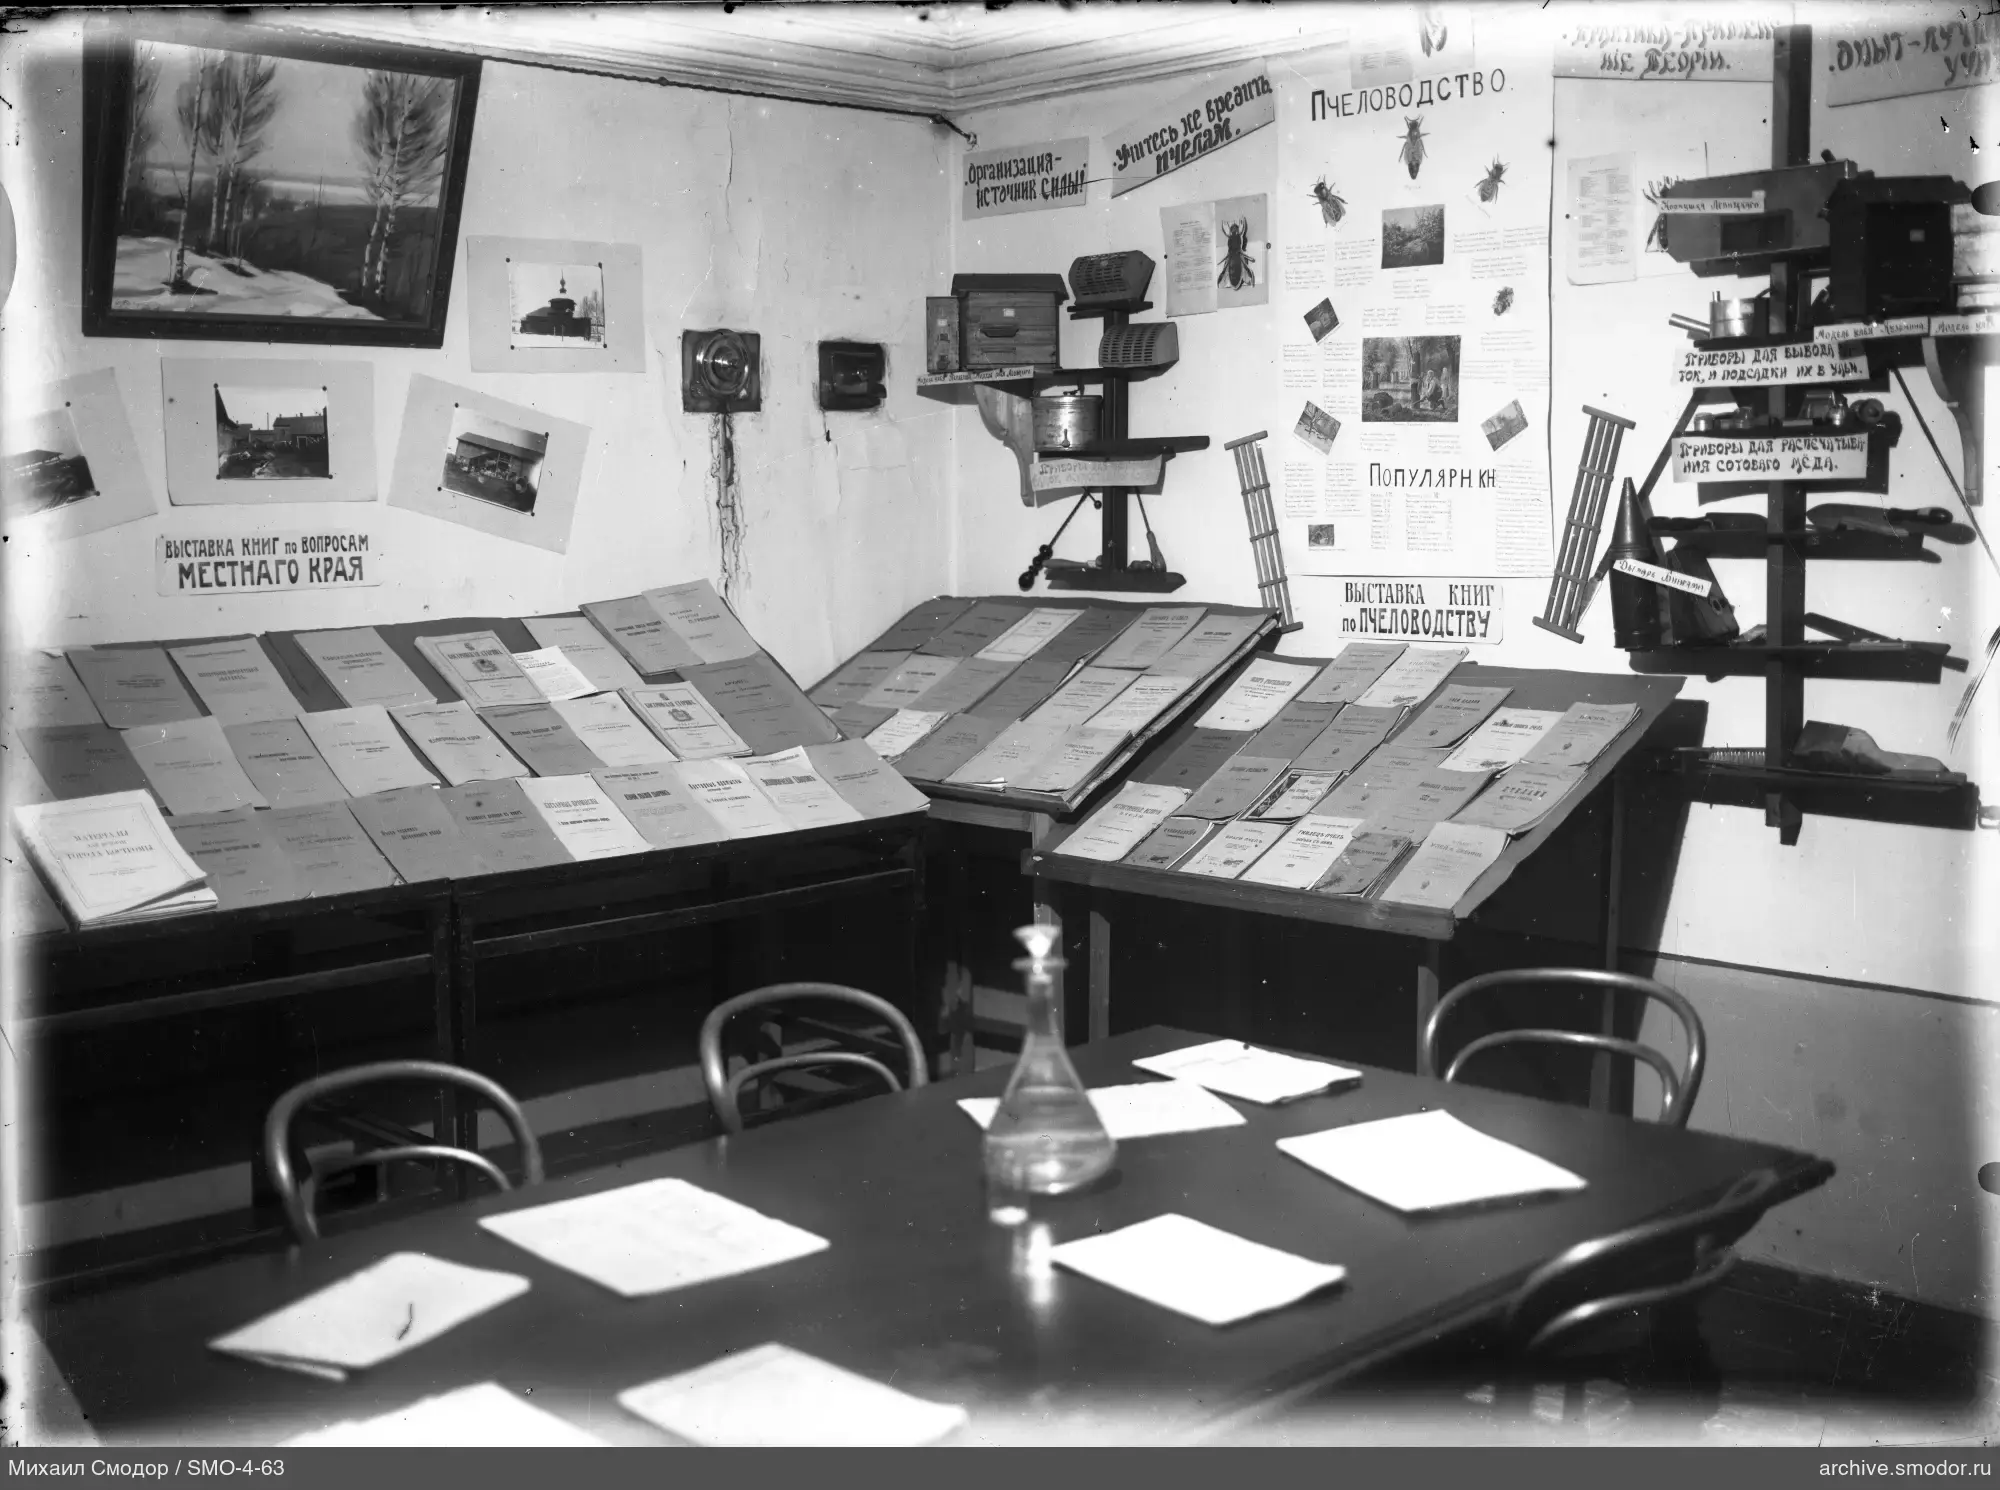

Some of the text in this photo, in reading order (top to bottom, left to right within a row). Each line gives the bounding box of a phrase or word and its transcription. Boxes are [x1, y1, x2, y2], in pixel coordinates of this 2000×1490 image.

[1752, 348, 1778, 364] ДЛЯ
[1748, 439, 1774, 455] ДЛЯ
[165, 538, 235, 559] ВЫСТАВКА
[241, 537, 279, 556] КНИГ
[301, 534, 369, 554] ВОПРОСАМ
[178, 555, 364, 589] МЕСТНАГО КРАЯ
[1344, 582, 1495, 607] ВЫСТАВКА КНИГ
[1359, 607, 1491, 638] ПЧЕЛОВОДСТВУ
